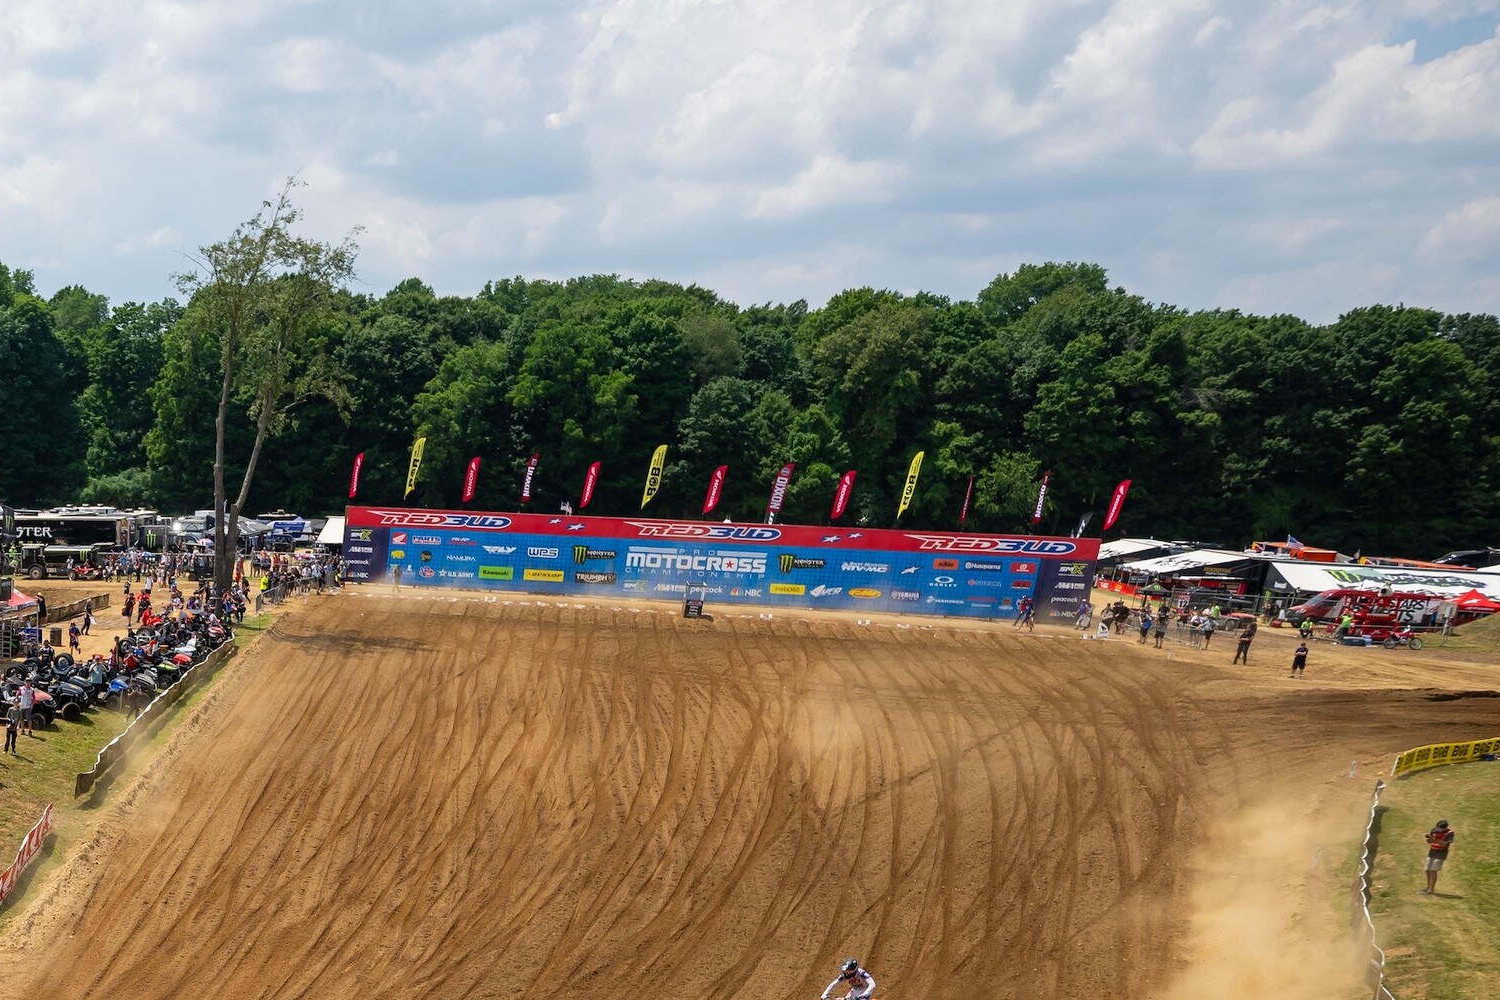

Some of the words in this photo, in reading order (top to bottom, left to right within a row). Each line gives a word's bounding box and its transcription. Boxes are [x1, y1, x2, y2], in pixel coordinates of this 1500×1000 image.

[647, 467, 661, 496] BOB
[770, 476, 788, 510] DIXXON
[368, 511, 512, 529] REDBUD
[625, 522, 782, 541] REDBUD
[528, 548, 558, 557] WPS
[679, 548, 716, 556] PRO
[904, 535, 1077, 555] REDBUD
[626, 553, 768, 573] MOTOCROSS
[625, 567, 765, 579] CHAMPIONSHIP
[744, 589, 762, 597] NBC
